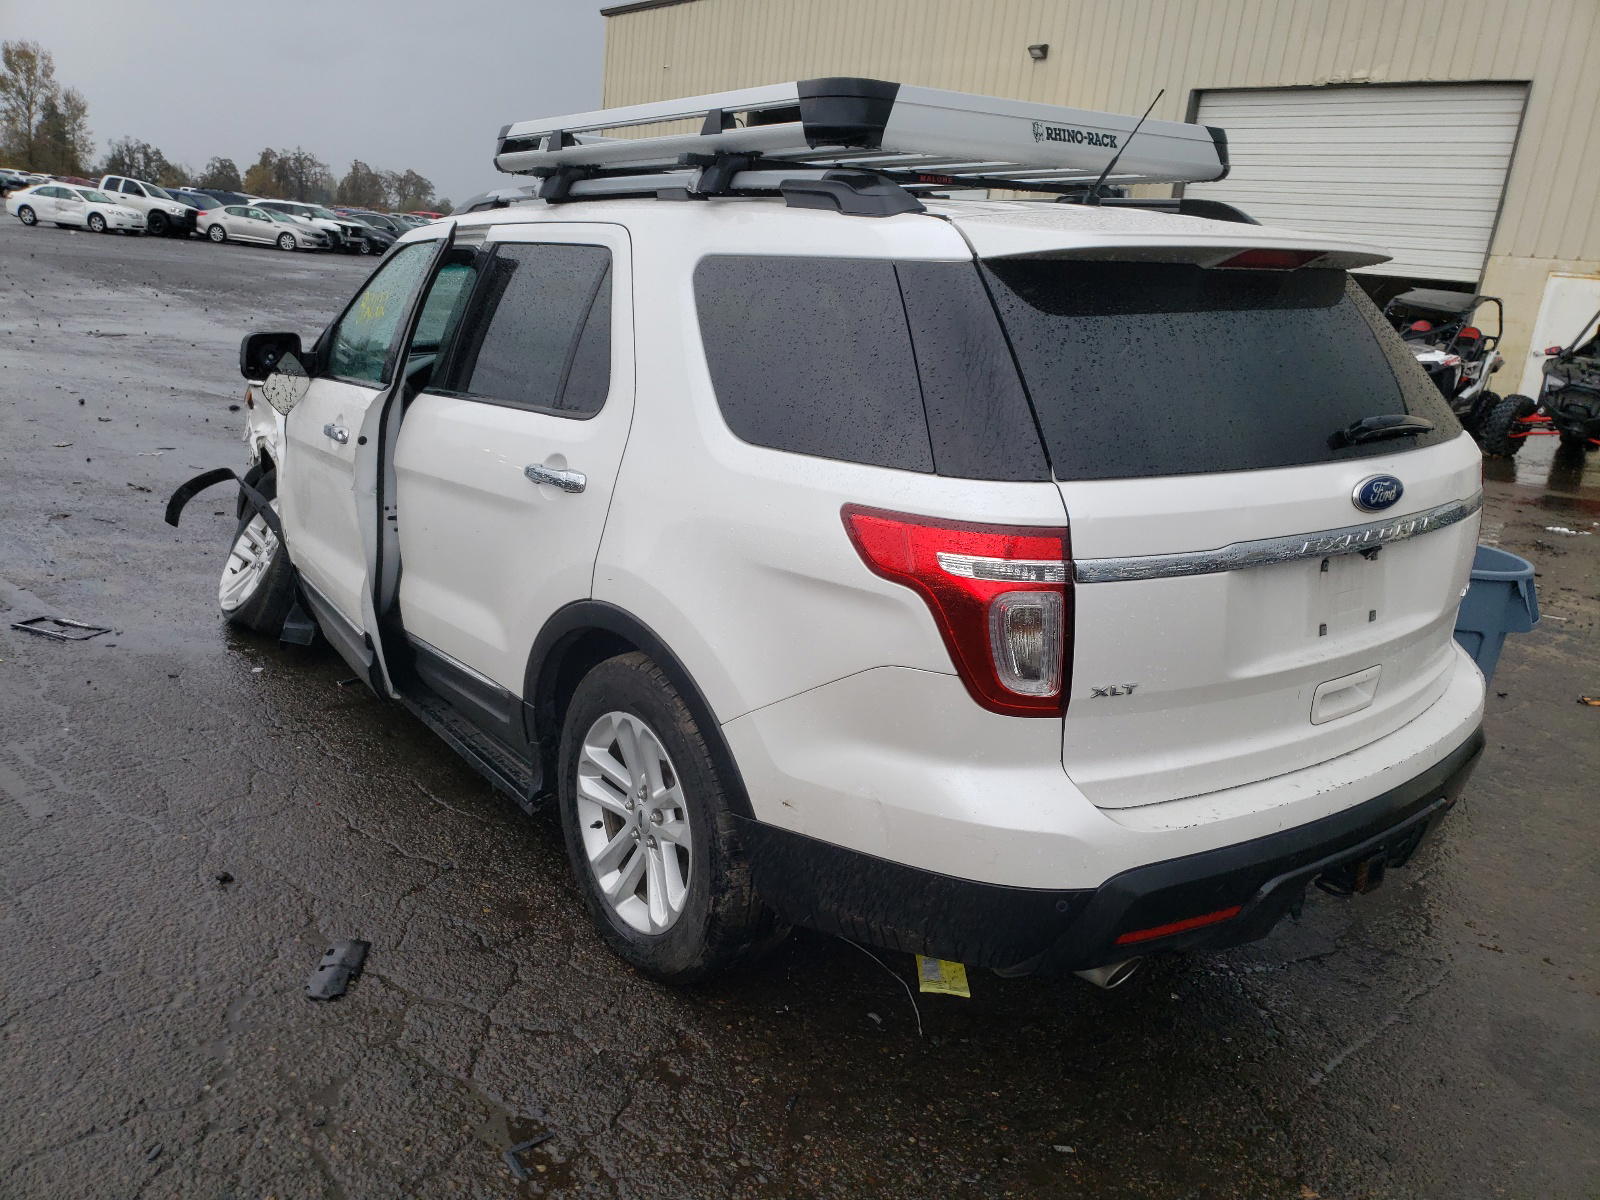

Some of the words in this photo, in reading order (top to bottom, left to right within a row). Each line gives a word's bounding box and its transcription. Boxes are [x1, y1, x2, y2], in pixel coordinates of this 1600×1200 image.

[1045, 127, 1118, 148] RHINO-RACK
[1370, 481, 1397, 504] Ford
[1090, 683, 1138, 699] XLT
